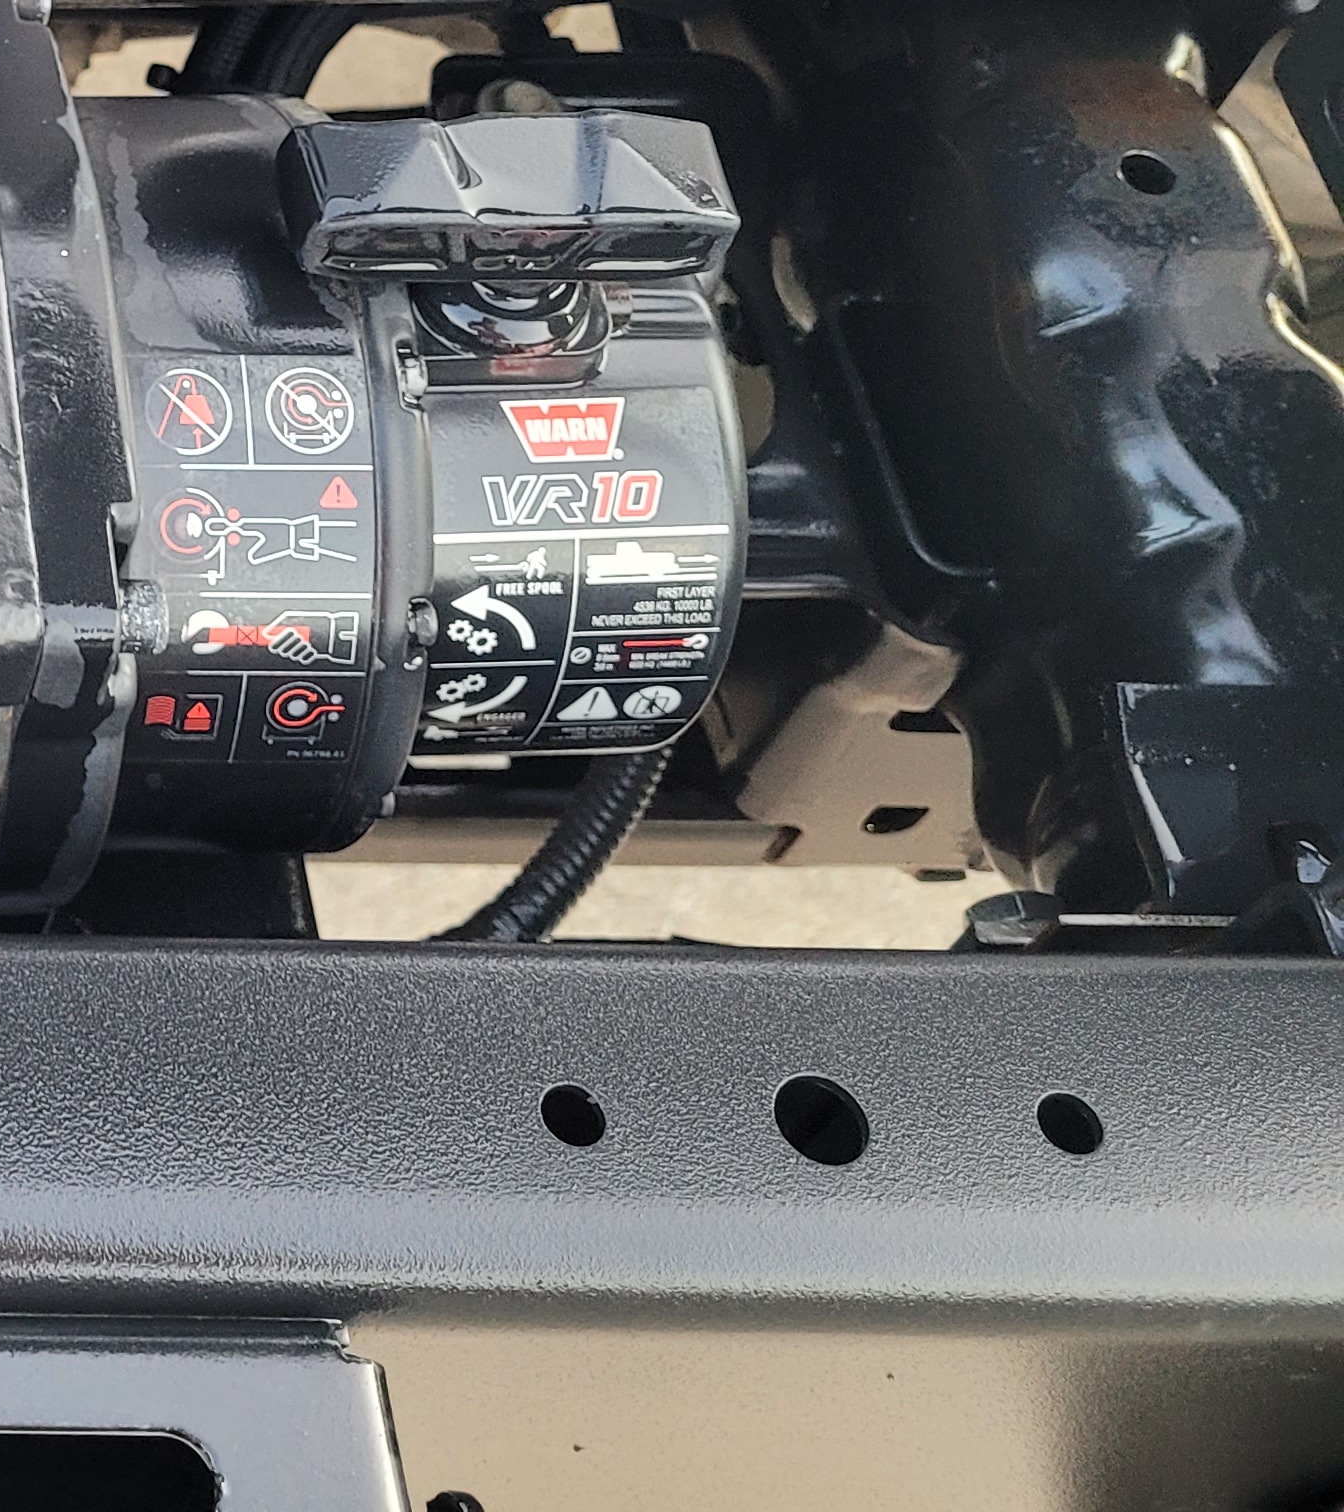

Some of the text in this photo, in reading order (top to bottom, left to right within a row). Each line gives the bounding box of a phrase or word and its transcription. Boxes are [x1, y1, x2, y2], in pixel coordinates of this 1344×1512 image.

[524, 417, 609, 443] WARN
[481, 470, 664, 526] VR10
[495, 581, 564, 596] FREE SPOOL
[656, 586, 716, 600] FIRST LAYER
[591, 615, 624, 627] NEVER
[624, 613, 662, 626] EXCEED
[663, 612, 684, 624] THIS
